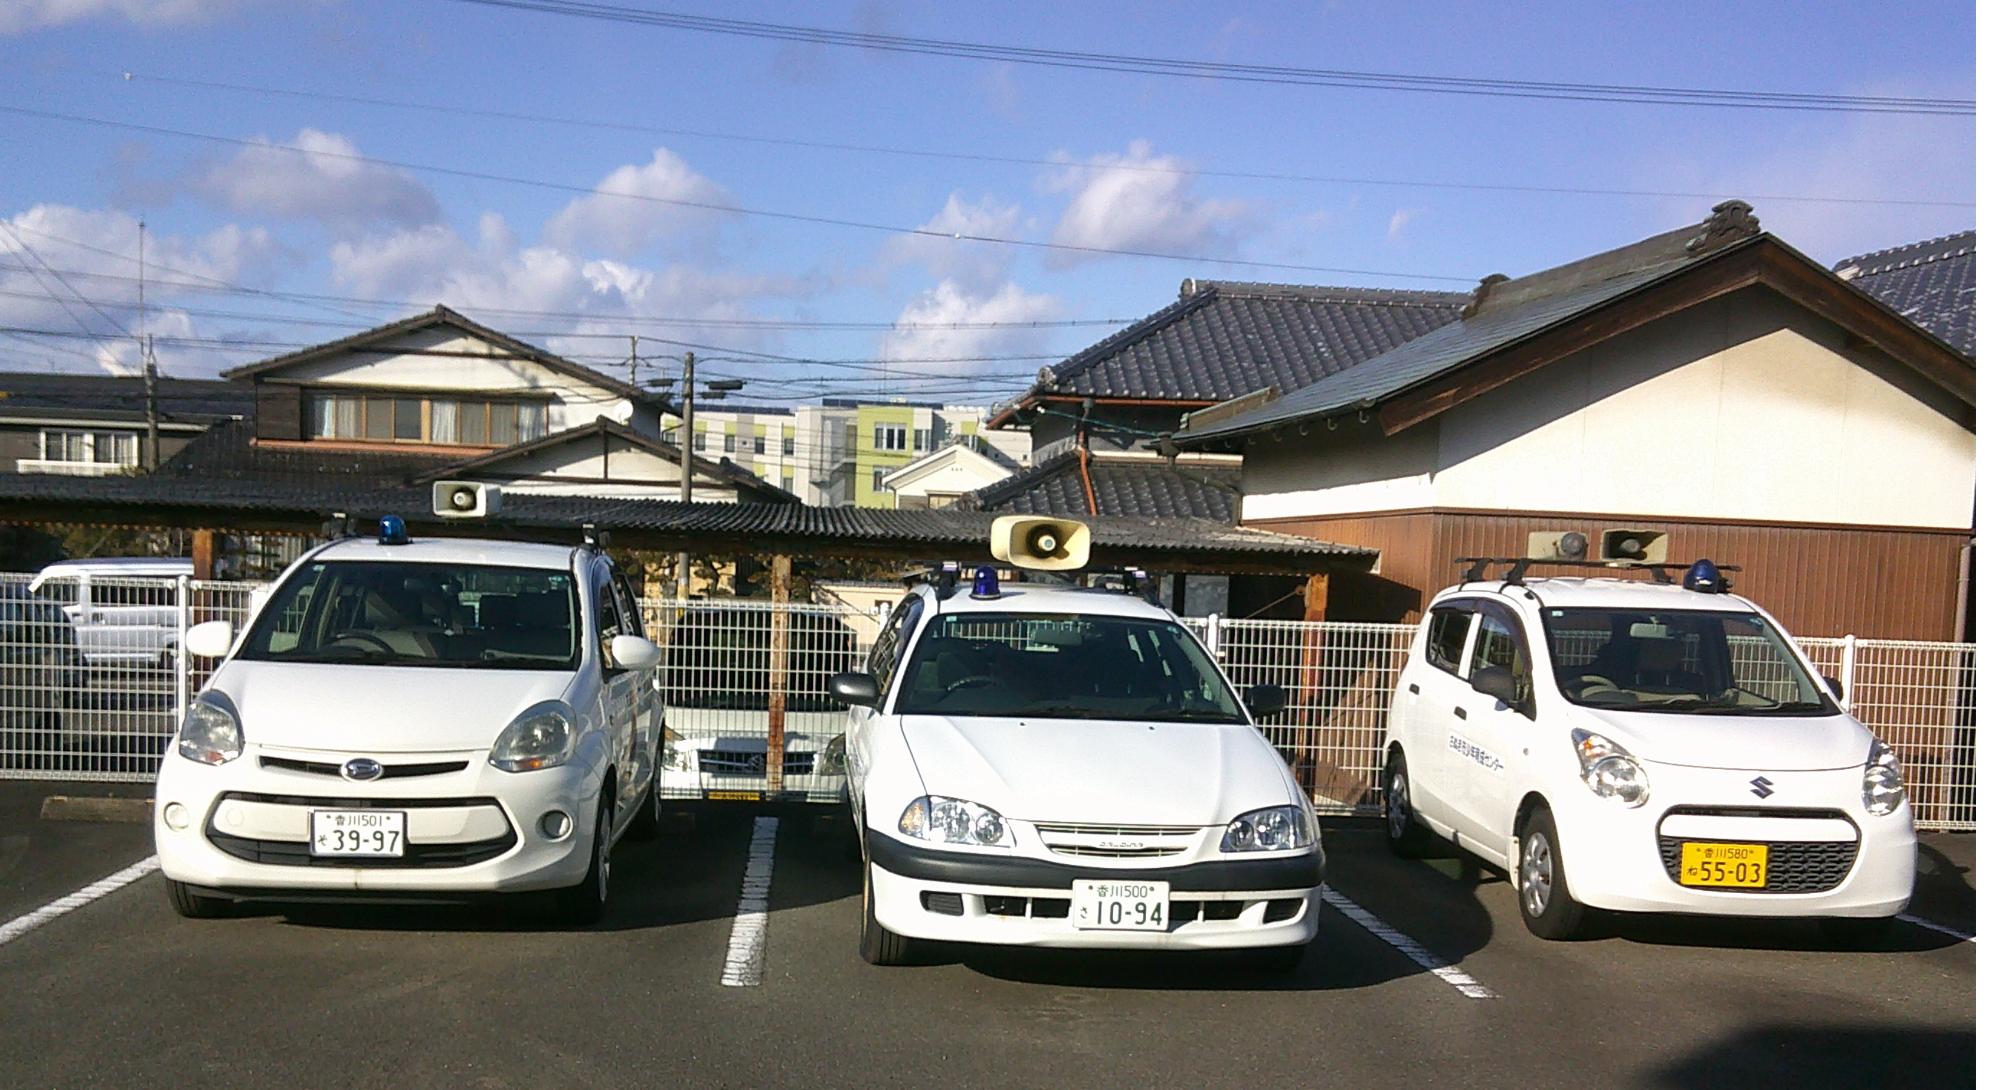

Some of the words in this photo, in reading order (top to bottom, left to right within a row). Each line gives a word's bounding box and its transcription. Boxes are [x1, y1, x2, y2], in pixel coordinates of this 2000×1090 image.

[333, 829, 400, 852] 39-97
[1701, 861, 1761, 883] 55-03
[1097, 901, 1162, 926] 10-94
